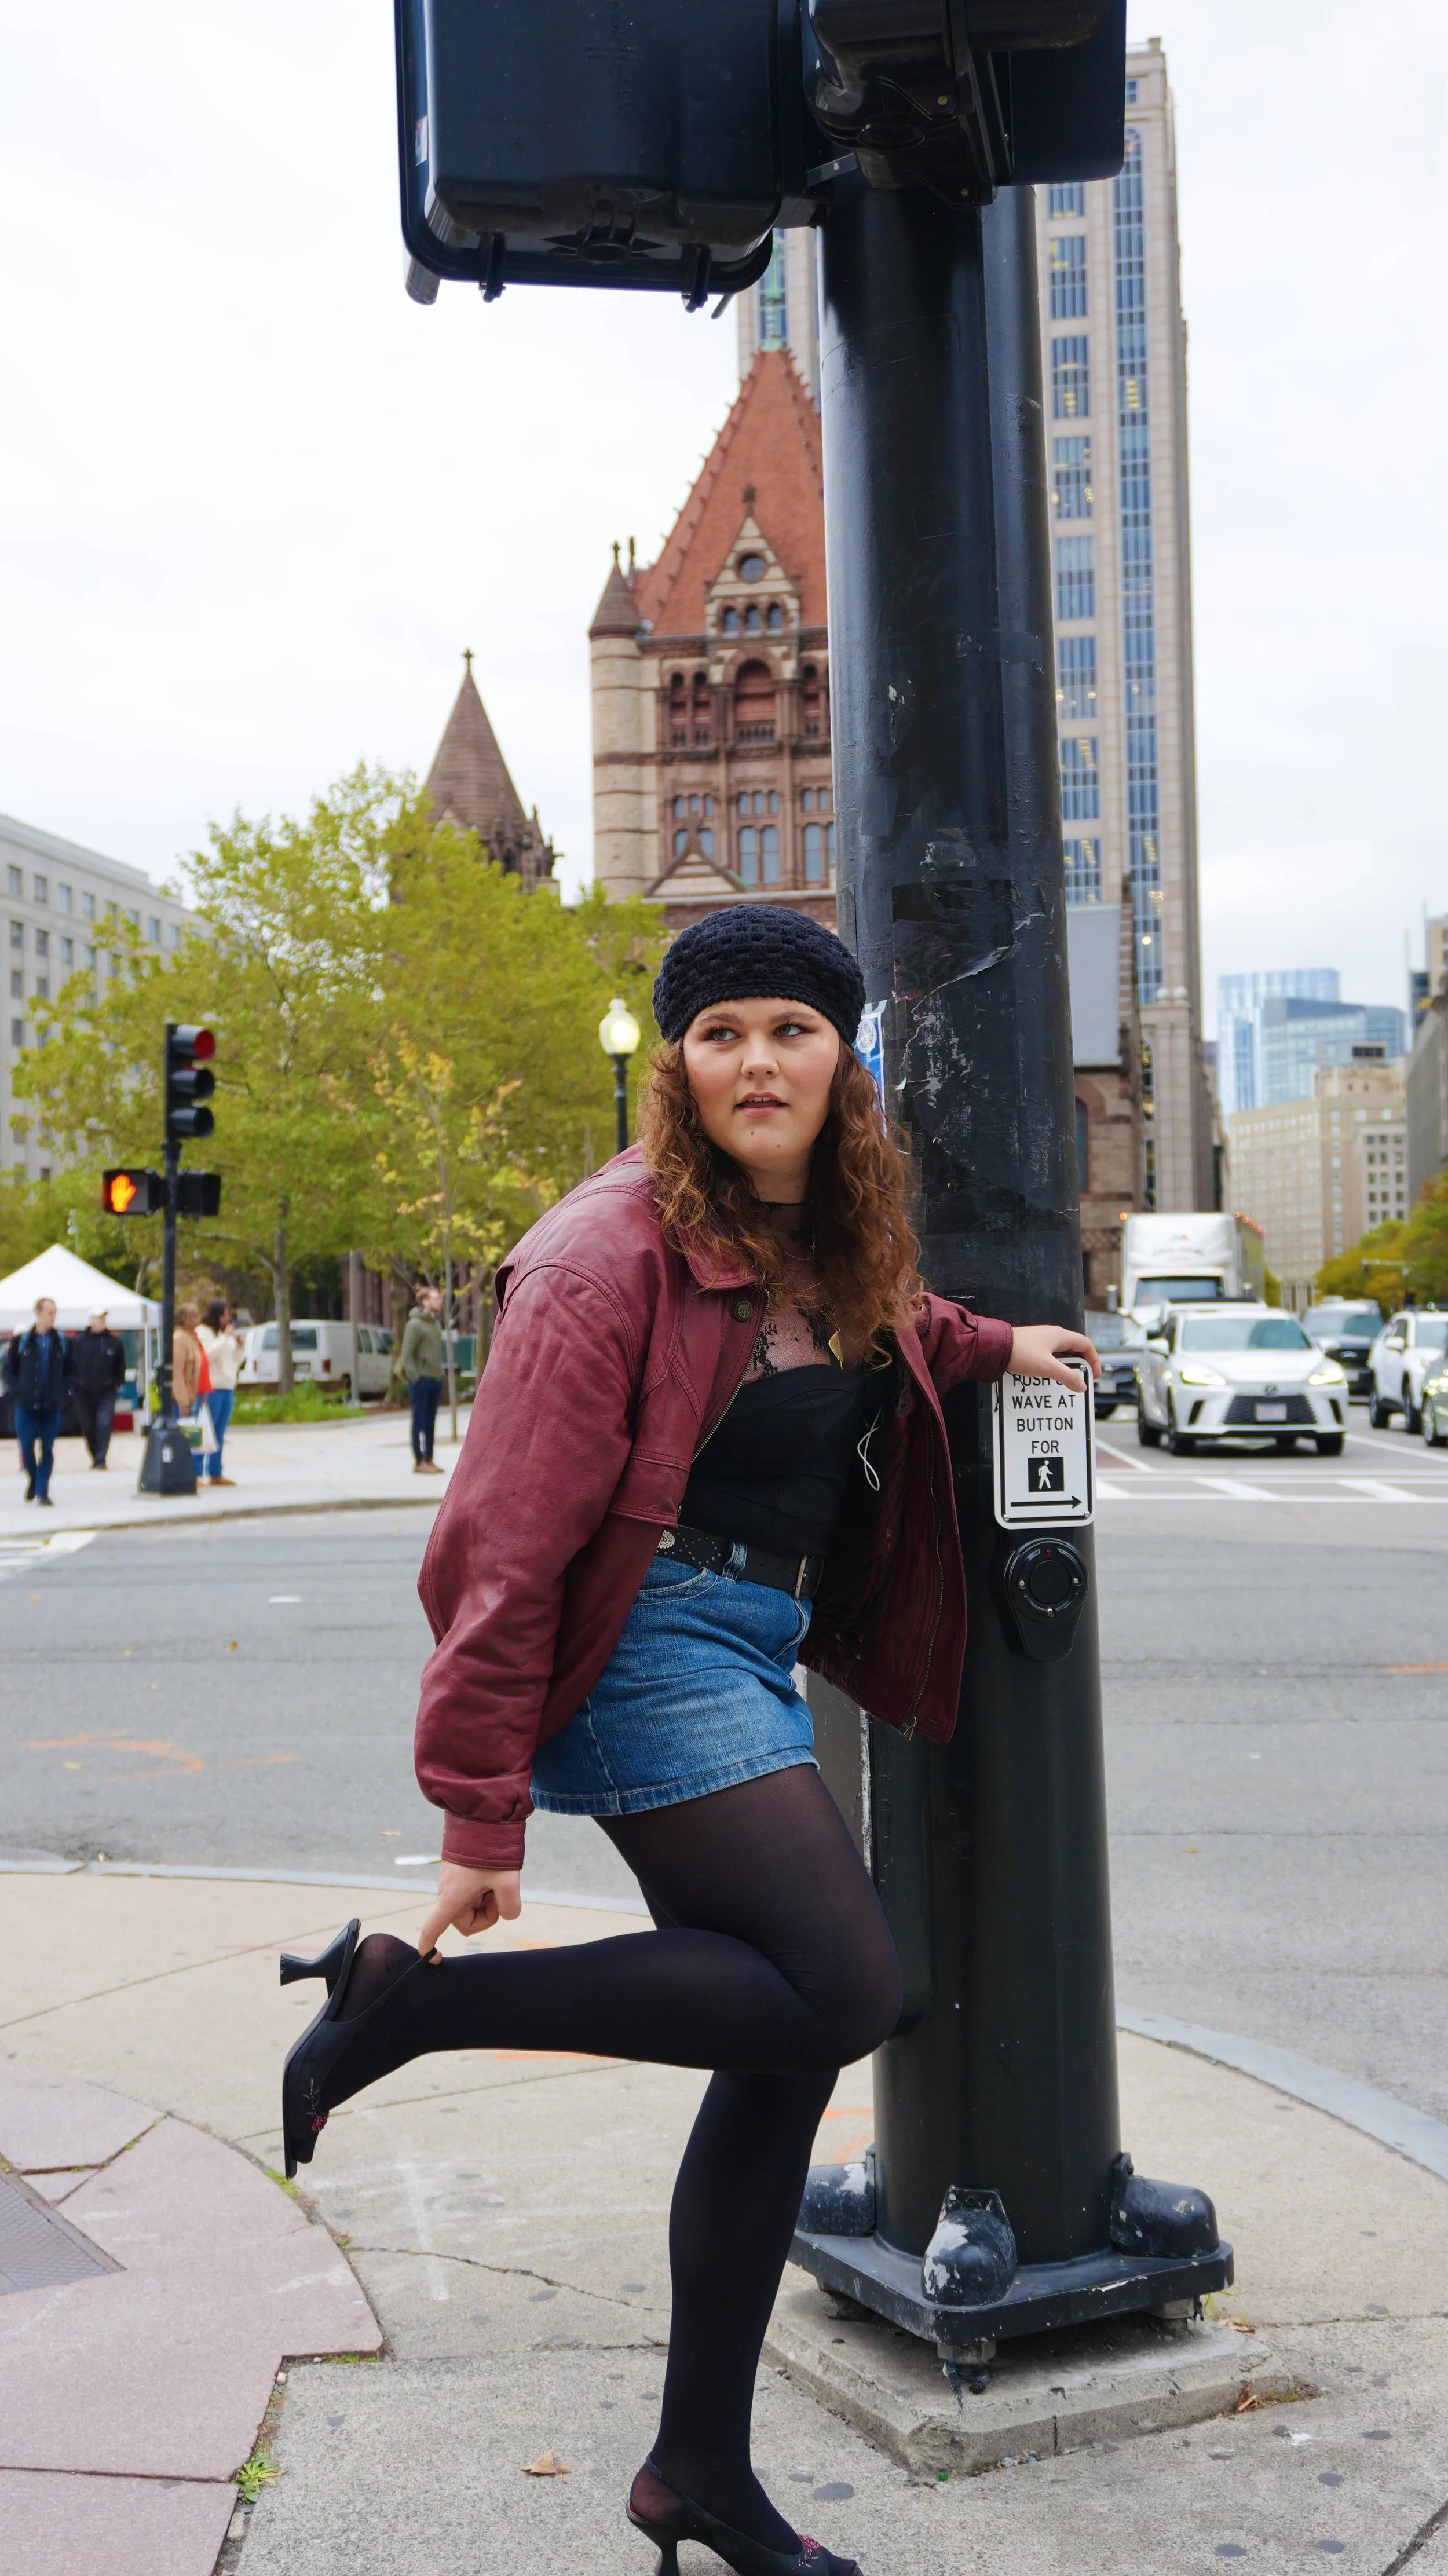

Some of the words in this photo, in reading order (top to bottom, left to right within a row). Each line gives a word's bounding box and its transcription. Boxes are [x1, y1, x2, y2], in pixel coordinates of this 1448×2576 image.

[1014, 1374, 1051, 1386] PUSH
[1012, 1395, 1052, 1409] WAVE
[1058, 1395, 1076, 1408] AT
[1017, 1417, 1073, 1432] BUTTON
[1032, 1440, 1059, 1454] FOR
